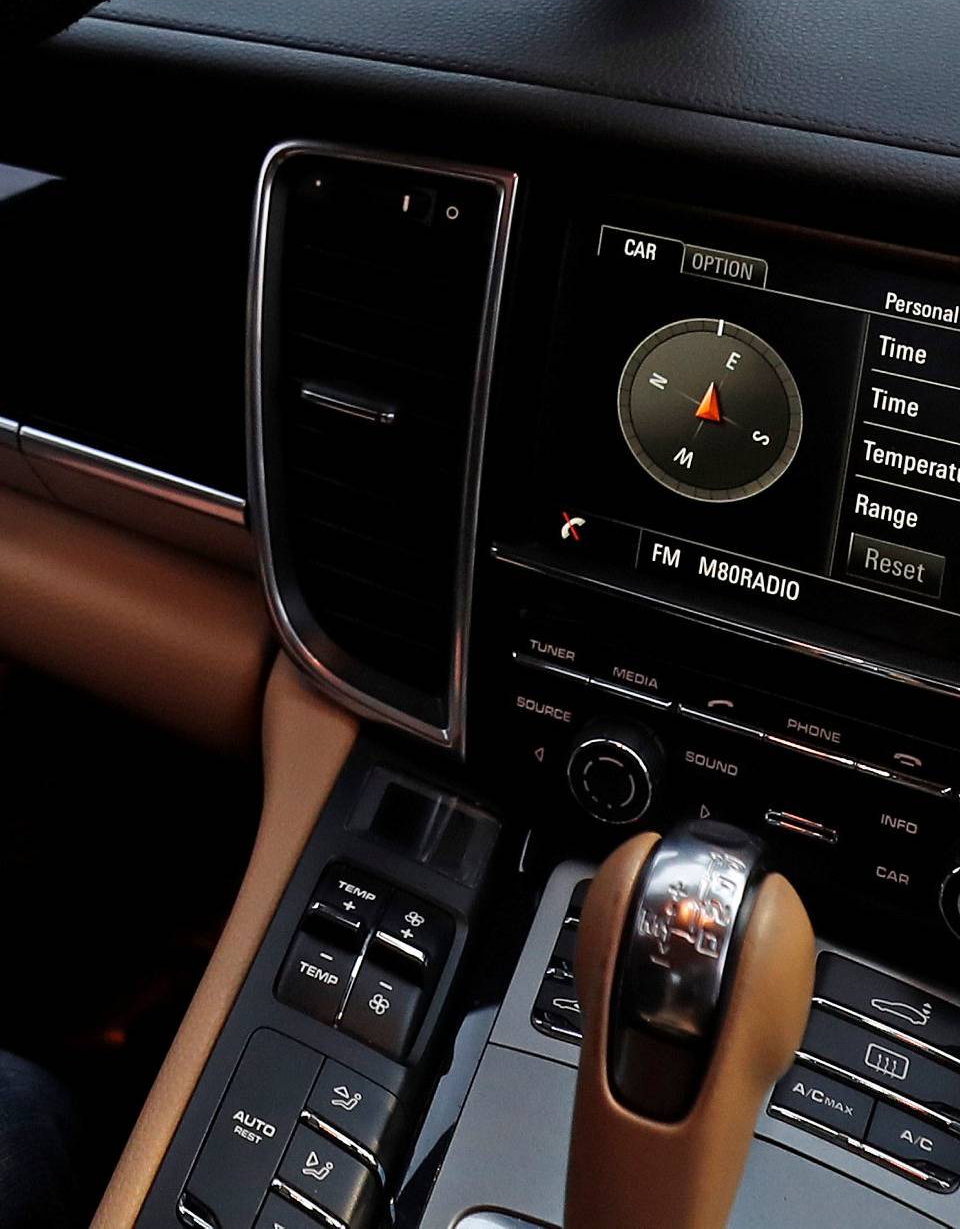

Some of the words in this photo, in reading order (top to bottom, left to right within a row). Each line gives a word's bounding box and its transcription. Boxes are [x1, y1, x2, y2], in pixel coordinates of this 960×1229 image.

[624, 238, 658, 261] CAR
[692, 252, 754, 281] OPTION
[885, 292, 959, 324] Personal
[726, 352, 741, 371] E
[879, 335, 926, 364] Time
[872, 387, 918, 417] Time
[855, 494, 917, 530] Range
[652, 543, 681, 568] FM
[865, 547, 925, 582] Reset
[530, 639, 576, 661] TUNER
[612, 666, 658, 689] MEDIA
[516, 696, 572, 722] SOURCE
[787, 718, 841, 743] PHONE
[685, 751, 738, 776] SOUND
[880, 814, 918, 835] INFO
[876, 866, 909, 885] CAR
[338, 880, 376, 902] TEMP
[300, 961, 338, 986] TEMP
[233, 1110, 275, 1138] AUTO
[234, 1125, 262, 1143] REST
[900, 1130, 933, 1152] A/C
